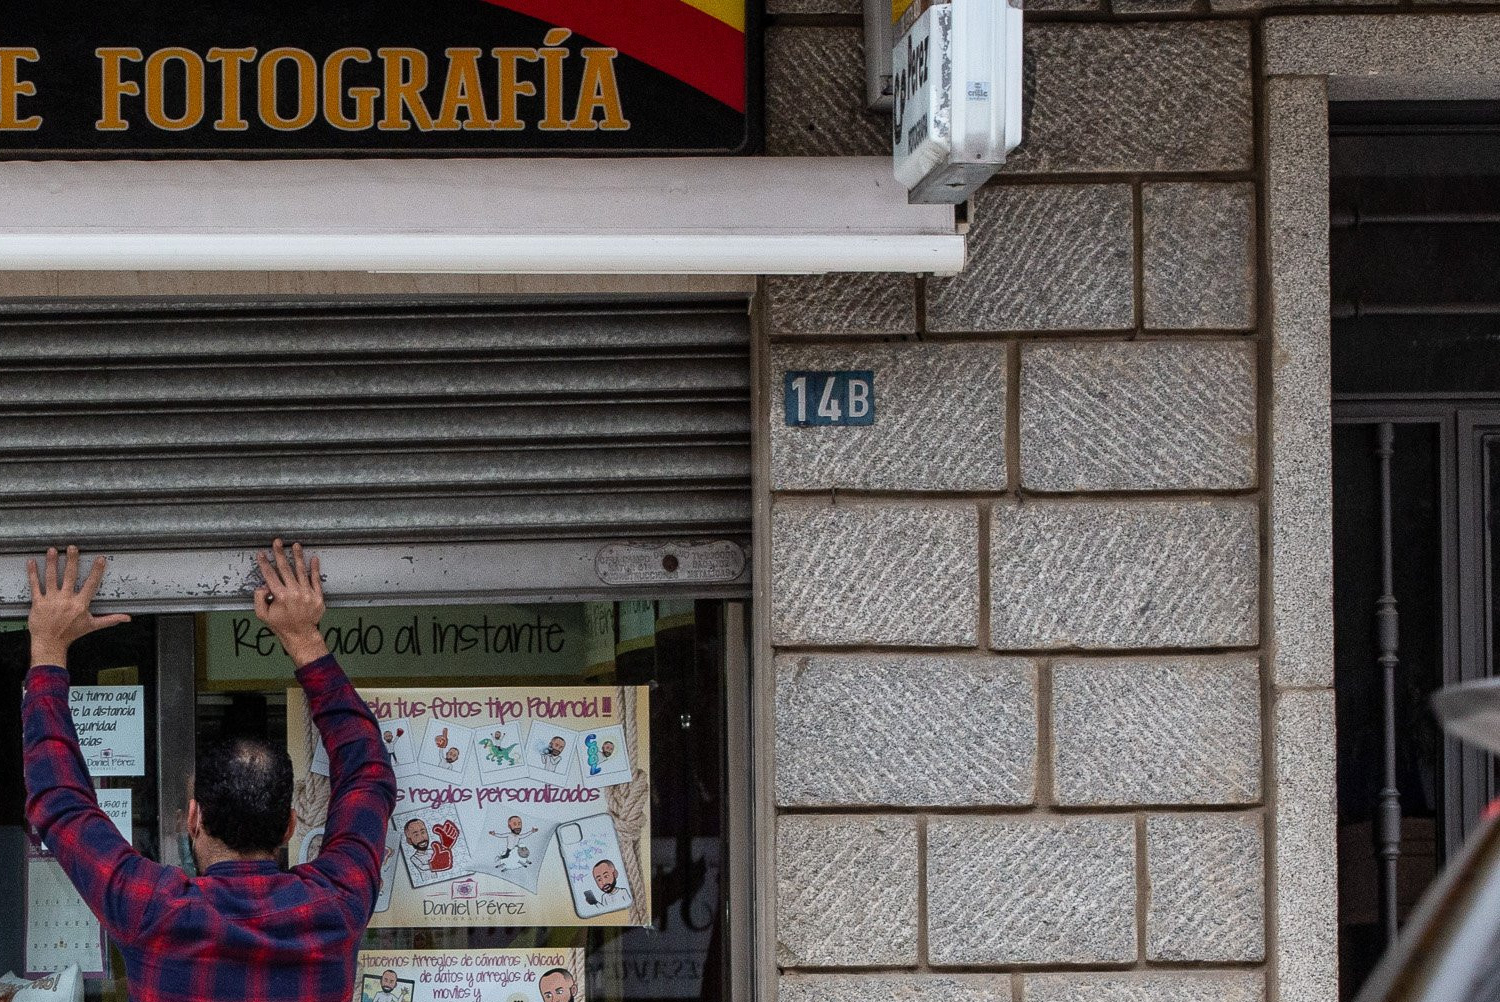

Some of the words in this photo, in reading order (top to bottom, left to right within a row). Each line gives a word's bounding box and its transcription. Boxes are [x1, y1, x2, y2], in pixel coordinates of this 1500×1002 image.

[95, 27, 631, 132] FOTOGRAFÍA
[791, 376, 870, 421] 14B
[233, 616, 384, 656] Reado
[397, 616, 422, 656] al
[432, 615, 567, 656] instante
[71, 691, 83, 702] Su
[86, 691, 114, 702] turno
[116, 689, 137, 704] aquí
[82, 705, 92, 717] la
[93, 704, 136, 717] distancia
[397, 697, 426, 718] tus
[427, 696, 481, 719] fotos
[485, 697, 523, 725] tipo
[526, 697, 599, 719] Polaroid
[75, 720, 118, 735] eguridad
[78, 736, 103, 746] acias
[88, 756, 110, 767] Daniel
[408, 785, 472, 809] regalos
[476, 785, 600, 810] personalizados
[423, 899, 471, 917] Daniel
[475, 898, 526, 917] Pérez
[361, 954, 409, 968] Hacemos
[412, 953, 458, 971] Arreglos
[460, 953, 473, 967] de
[475, 952, 521, 967] cámaras
[419, 969, 432, 981] de
[434, 969, 463, 981] datos
[465, 973, 474, 987] y
[476, 969, 521, 987] arreglos
[523, 969, 536, 981] de
[432, 986, 471, 999] moviles
